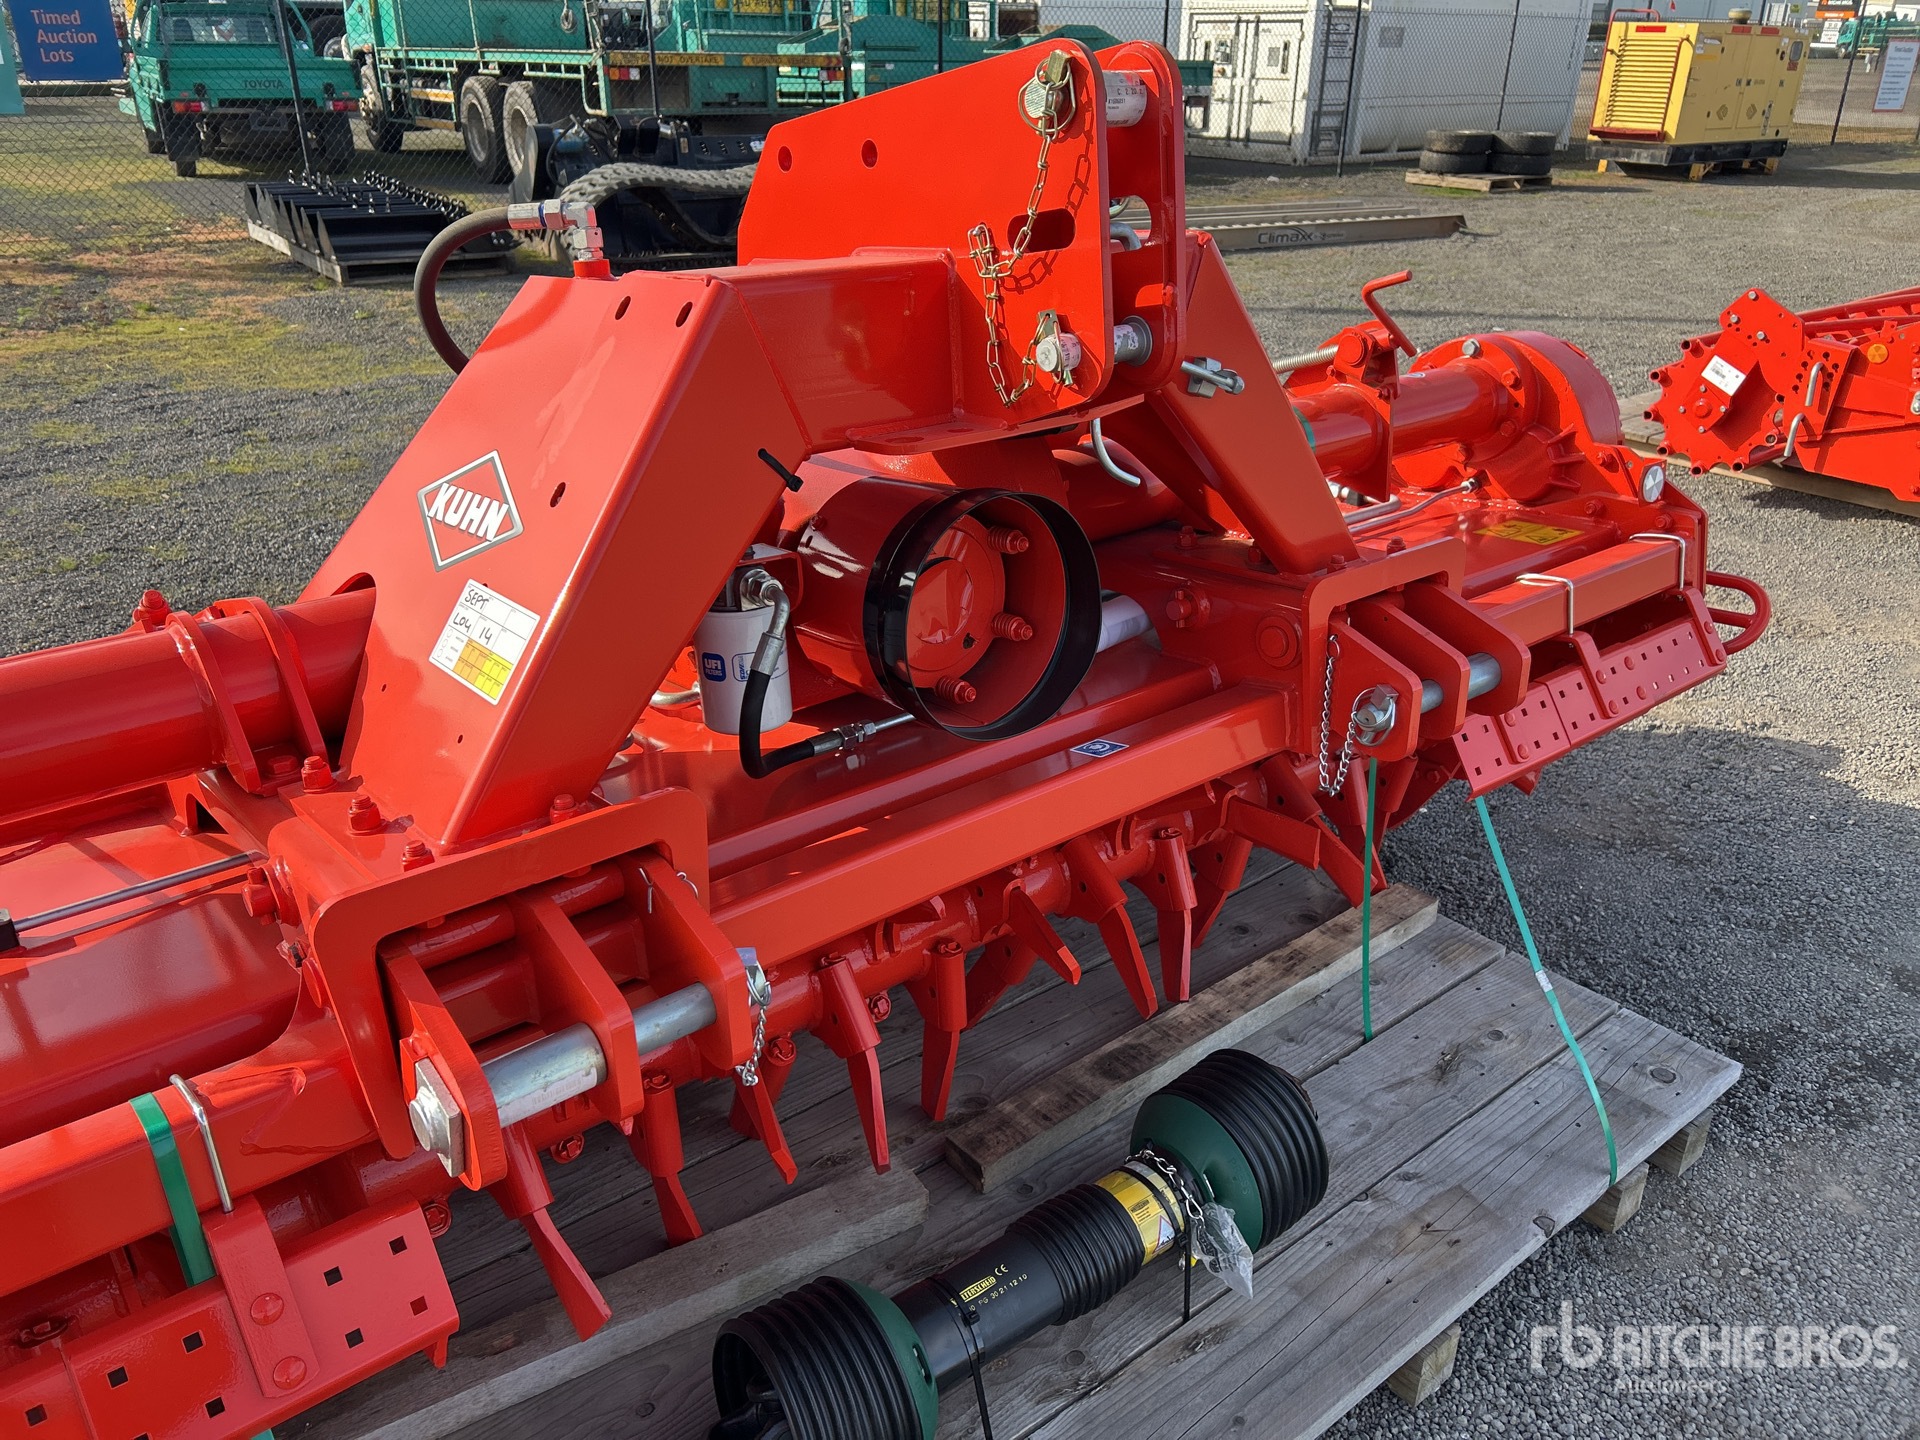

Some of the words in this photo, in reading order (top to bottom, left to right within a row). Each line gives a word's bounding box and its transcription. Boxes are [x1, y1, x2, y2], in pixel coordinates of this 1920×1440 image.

[30, 9, 82, 25] Timed
[37, 28, 98, 44] Auction
[40, 47, 75, 62] Lots
[243, 80, 285, 89] TOYOTA
[427, 482, 509, 542] KUHN
[464, 588, 490, 610] SEPT
[478, 626, 493, 646] 14
[704, 657, 722, 670] UFI
